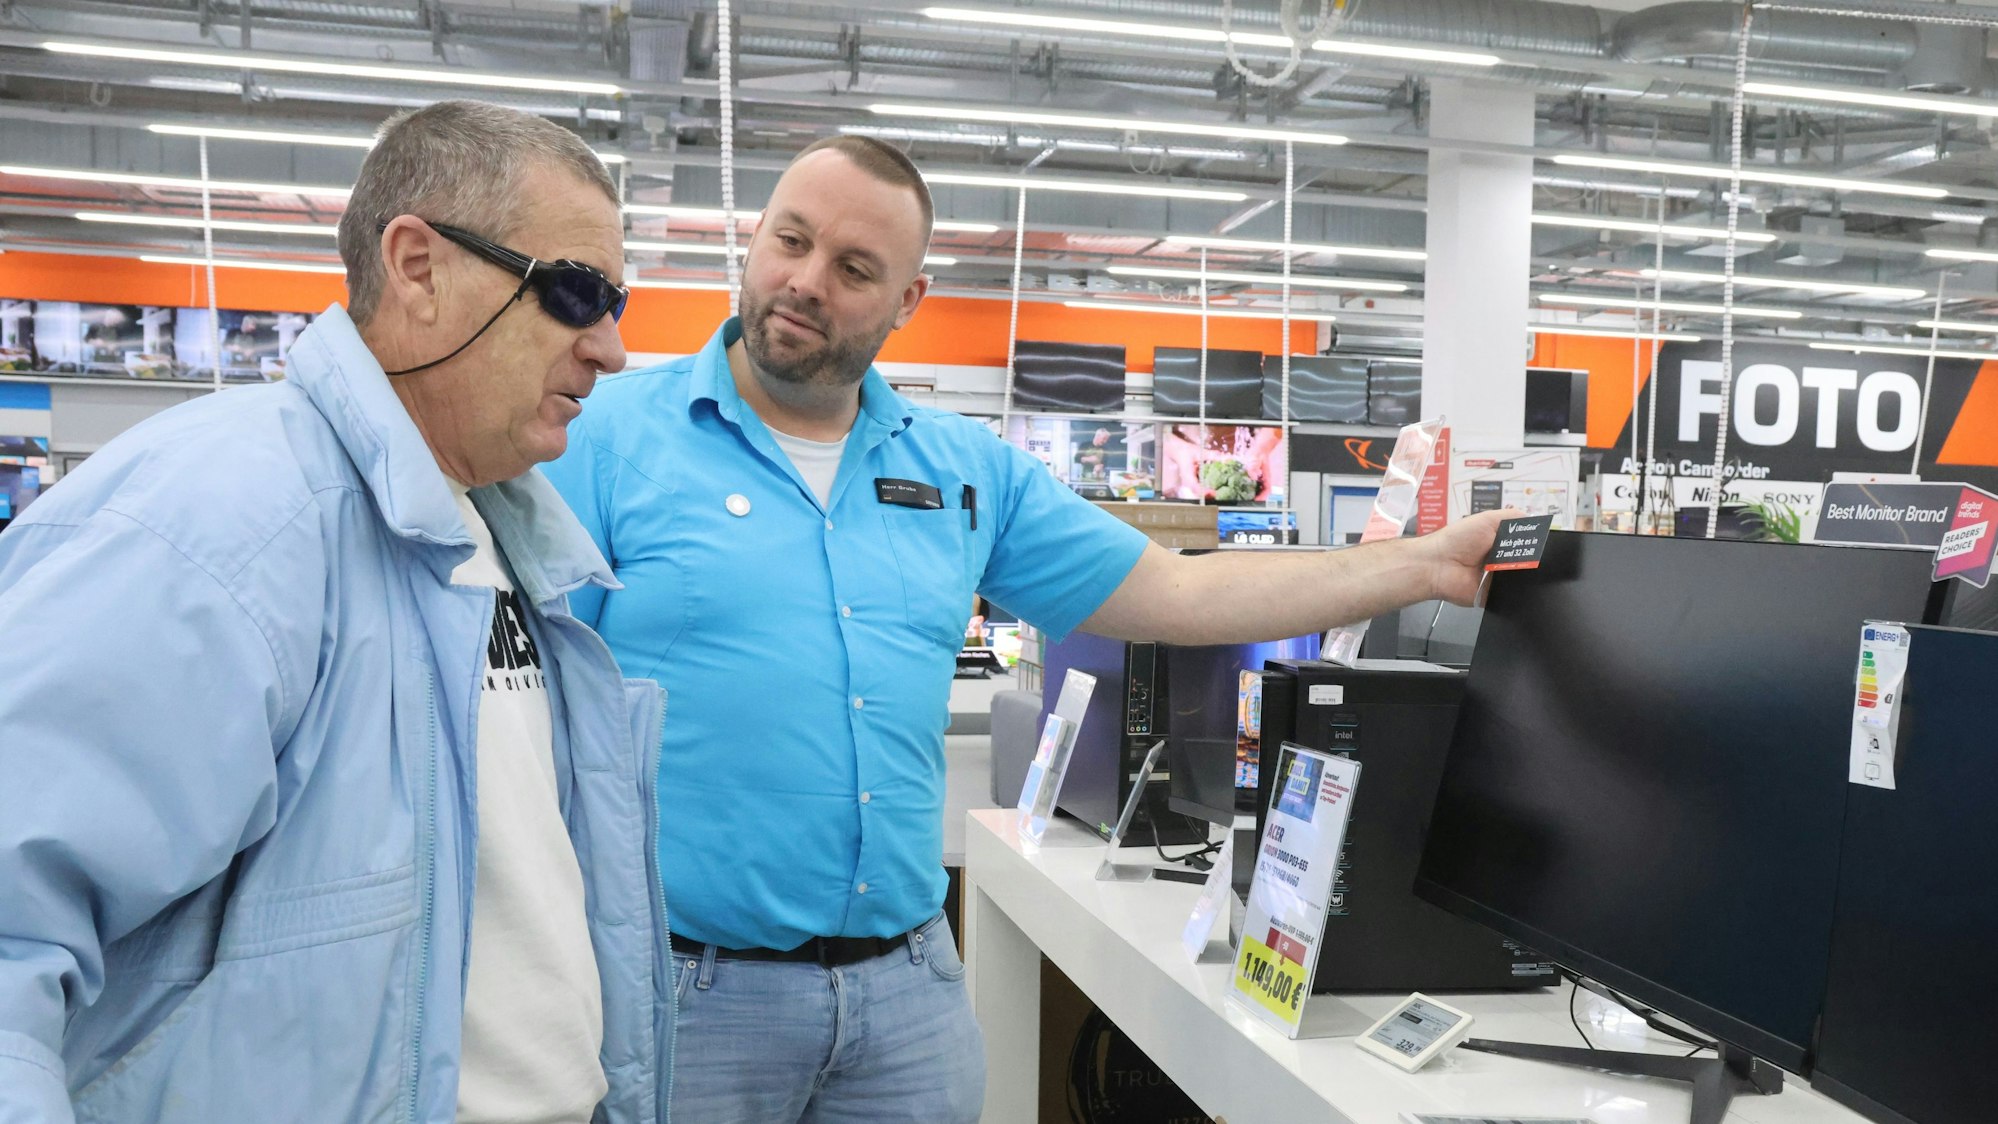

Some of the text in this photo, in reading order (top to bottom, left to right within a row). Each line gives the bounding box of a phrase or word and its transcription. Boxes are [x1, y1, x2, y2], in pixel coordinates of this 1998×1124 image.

[1678, 359, 1922, 453] FOTO
[1679, 459, 1770, 479] Camorder
[1692, 487, 1739, 503] Nion
[1763, 492, 1815, 505] SONY
[1827, 503, 1948, 523] Best Monitor Brand
[1960, 501, 1983, 512] digital
[1957, 510, 1980, 519] trends
[1234, 534, 1275, 544] LG OLED
[1500, 539, 1512, 547] Mich
[1512, 538, 1524, 548] gibt
[1532, 537, 1538, 545] in
[1496, 550, 1504, 558] 27
[1503, 549, 1513, 557] und
[1514, 548, 1521, 556] 32
[1941, 540, 1973, 555] CHOICE
[1335, 731, 1353, 739] intel
[1266, 823, 1285, 843] ACER
[1277, 849, 1290, 864] 3000
[1243, 952, 1293, 1004] 1.149,00
[1113, 1070, 1174, 1087] TRU
